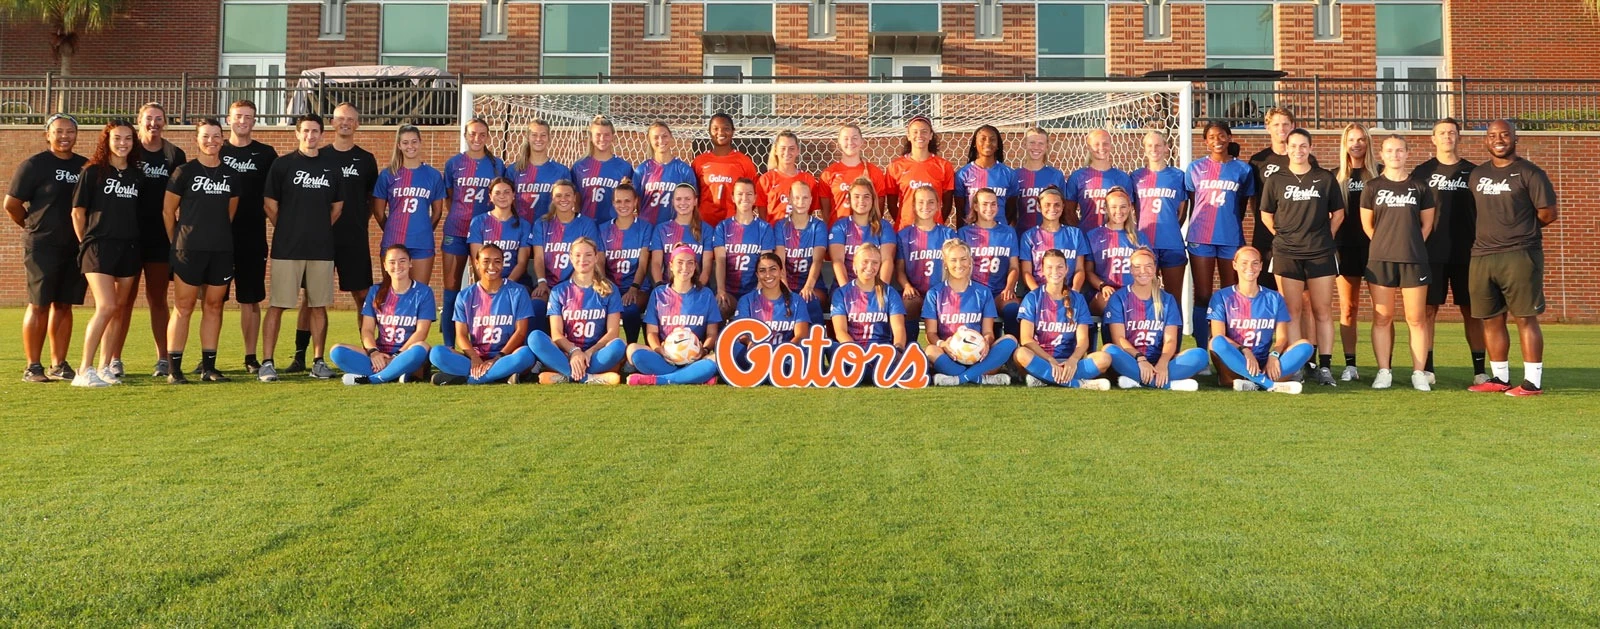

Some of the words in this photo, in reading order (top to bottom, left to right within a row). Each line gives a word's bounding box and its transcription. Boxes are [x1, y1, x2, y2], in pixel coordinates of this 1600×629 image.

[222, 155, 258, 171] Florida
[55, 169, 80, 181] Flor
[293, 170, 330, 187] Florida
[708, 174, 732, 183] Gators
[1428, 174, 1469, 189] Florida
[103, 178, 138, 197] Florida
[191, 175, 231, 193] Florida
[457, 177, 491, 188] FLORID
[645, 182, 676, 191] FLORID
[1200, 180, 1240, 191] FLORIDA
[1476, 177, 1512, 191] Florida
[393, 187, 430, 199] FLORIDA
[464, 188, 485, 203] 24
[592, 188, 604, 202] 16
[717, 185, 723, 200] 1
[1084, 189, 1108, 199] FLOR
[1138, 188, 1176, 199] FLORIDA
[1210, 191, 1226, 206] 14
[1284, 184, 1321, 199] Florida
[1375, 189, 1417, 205] Florida
[402, 198, 418, 213] 13
[530, 194, 540, 209] 7
[650, 193, 670, 207] 34
[1152, 199, 1162, 214] 9
[544, 243, 572, 252] FLORI
[785, 247, 813, 257] FLORID
[970, 246, 1010, 257] FLORIDA
[554, 253, 569, 269] 19
[910, 249, 943, 261] FLORID
[616, 260, 631, 274] 10
[735, 255, 750, 271] 12
[793, 260, 808, 273] 18
[924, 261, 934, 276] 3
[979, 258, 1000, 273] 28
[1112, 258, 1131, 273] 22
[376, 314, 417, 326] FLORIDA
[473, 315, 513, 327] FLORIDA
[563, 309, 606, 321] FLORIDA
[661, 315, 704, 326] FLORIDA
[848, 312, 888, 323] FLORIDA
[940, 313, 981, 324] FLORIDA
[573, 322, 595, 338] 30
[1127, 319, 1164, 331] FLORIDA
[1230, 319, 1274, 329] FLORIDA
[384, 328, 406, 343] 33
[482, 328, 502, 344] 23
[862, 325, 874, 339] 11
[1134, 332, 1156, 346] 25
[1244, 331, 1262, 347] 21
[1051, 335, 1062, 346] 4
[716, 318, 930, 389] Gators
